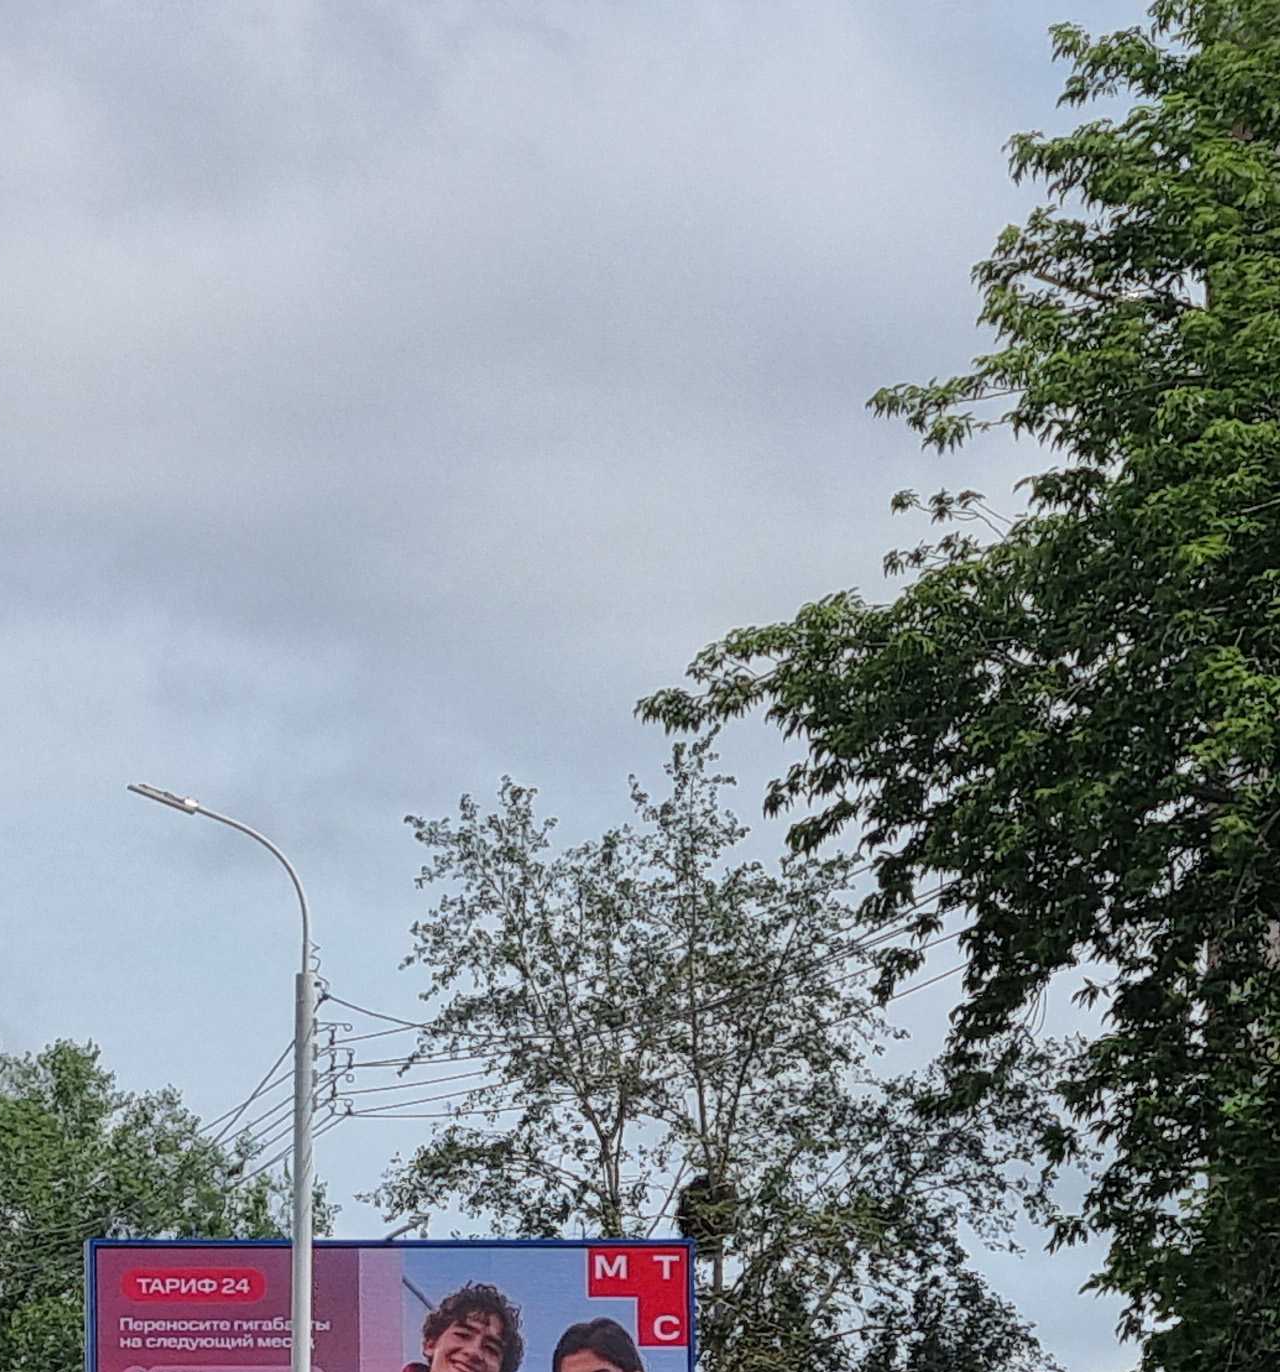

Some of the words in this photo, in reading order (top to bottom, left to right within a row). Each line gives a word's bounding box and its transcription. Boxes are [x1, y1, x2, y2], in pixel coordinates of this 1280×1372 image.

[136, 1278, 217, 1294] ТАРИФ
[221, 1277, 251, 1294] 24
[120, 1317, 230, 1333] Переносите
[120, 1336, 142, 1348] на
[146, 1334, 254, 1350] следующий
